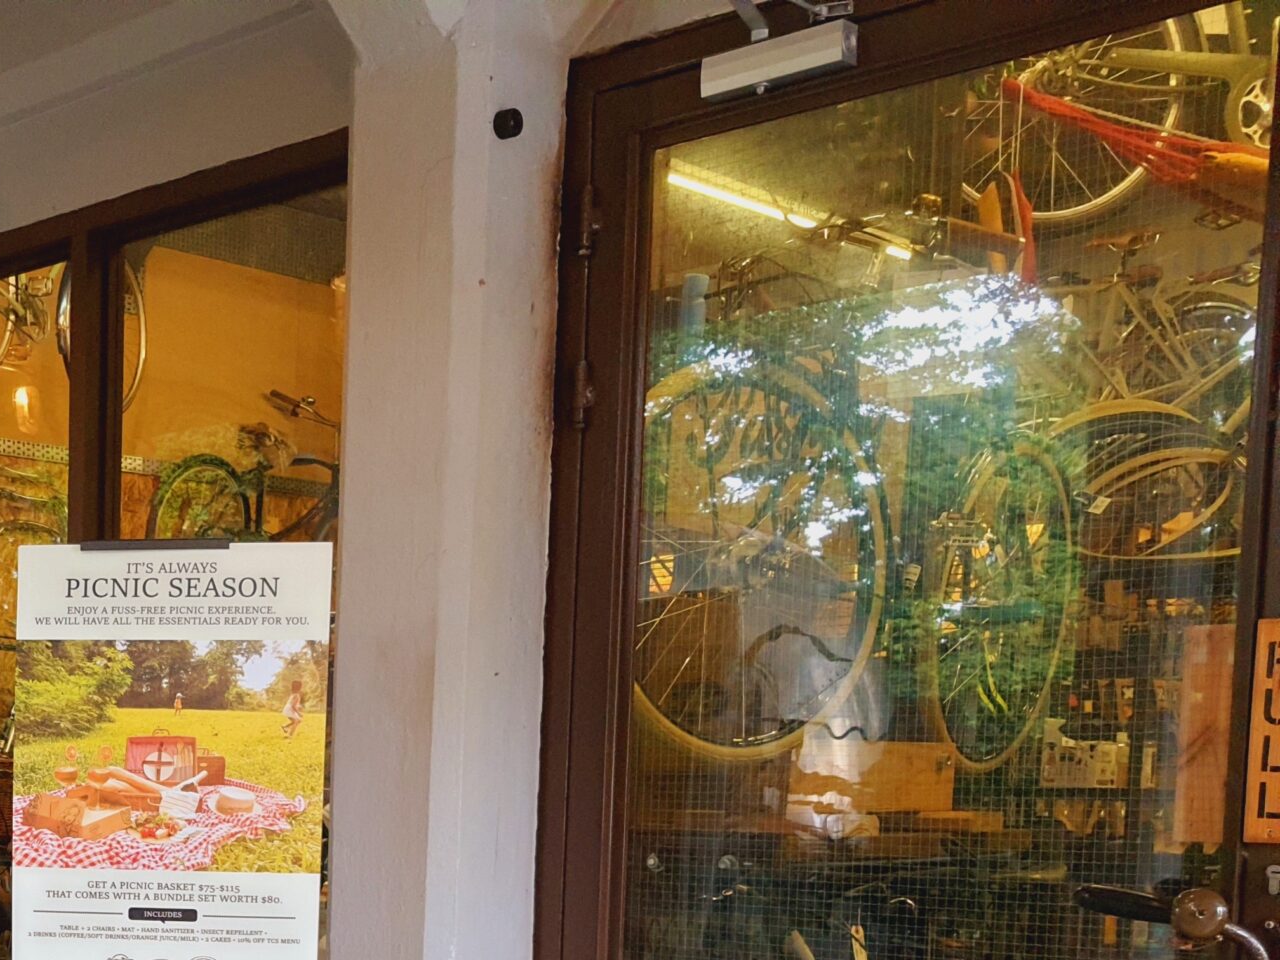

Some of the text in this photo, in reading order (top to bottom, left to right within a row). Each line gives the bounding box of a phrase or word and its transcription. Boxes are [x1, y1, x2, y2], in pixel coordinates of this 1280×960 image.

[126, 562, 218, 574] IT'S ALWAYS
[64, 576, 280, 598] PICNIC SEASON
[66, 605, 276, 616] ENJOY A FUSS-FREE PICNIC EXPERIENCE.
[34, 616, 310, 625] WE WILL HAVE ALL THE ESSENTIALS READY FOR YOU.
[87, 880, 241, 894] GET A PICNIC BASKET $75-$115
[45, 890, 73, 899] THAT
[75, 890, 110, 900] COMES
[113, 892, 141, 901] WITH
[154, 892, 195, 902] BUNDLE
[197, 894, 217, 903] SET
[219, 894, 259, 904] WORTH
[261, 896, 284, 904] $80.
[143, 911, 183, 919] INCLUDES
